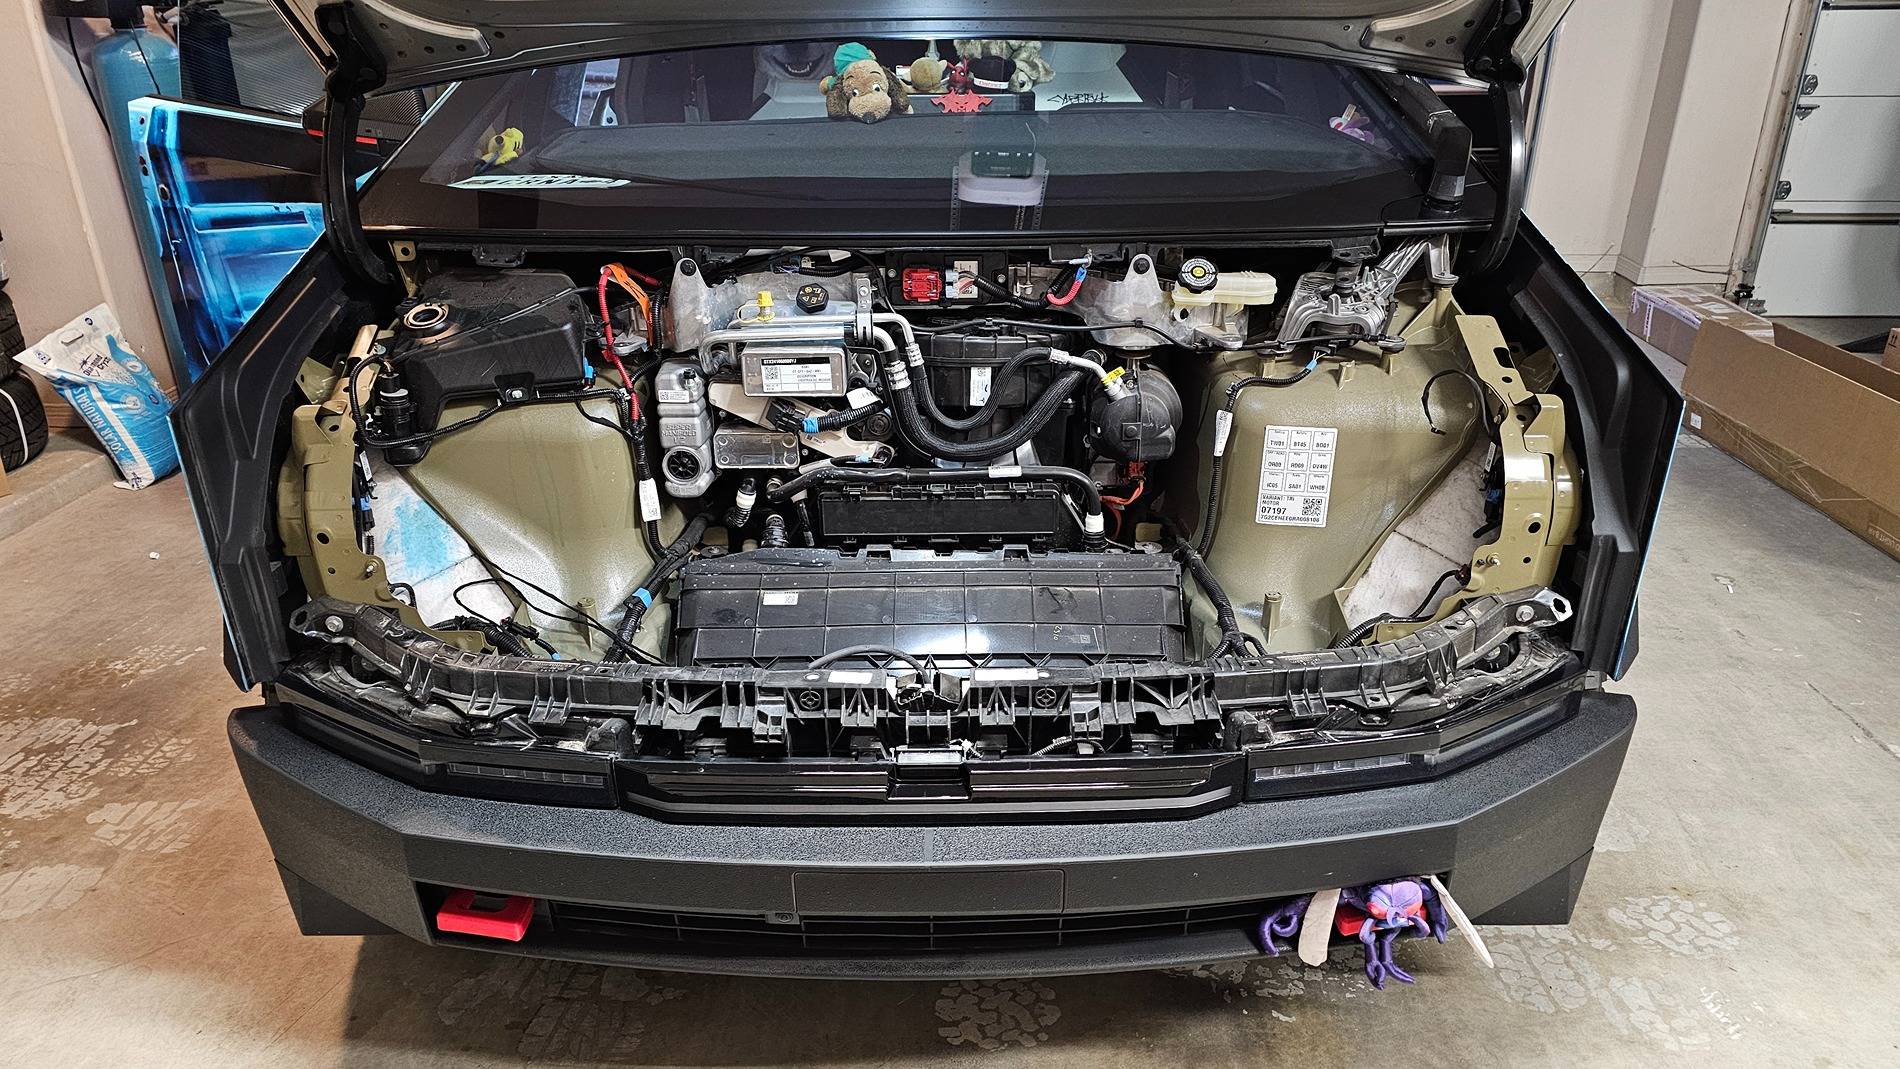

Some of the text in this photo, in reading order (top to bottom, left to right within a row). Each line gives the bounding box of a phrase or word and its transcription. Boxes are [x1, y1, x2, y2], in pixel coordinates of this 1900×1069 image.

[74, 386, 125, 455] SOLAR NATURALS
[1261, 506, 1287, 515] 07197
